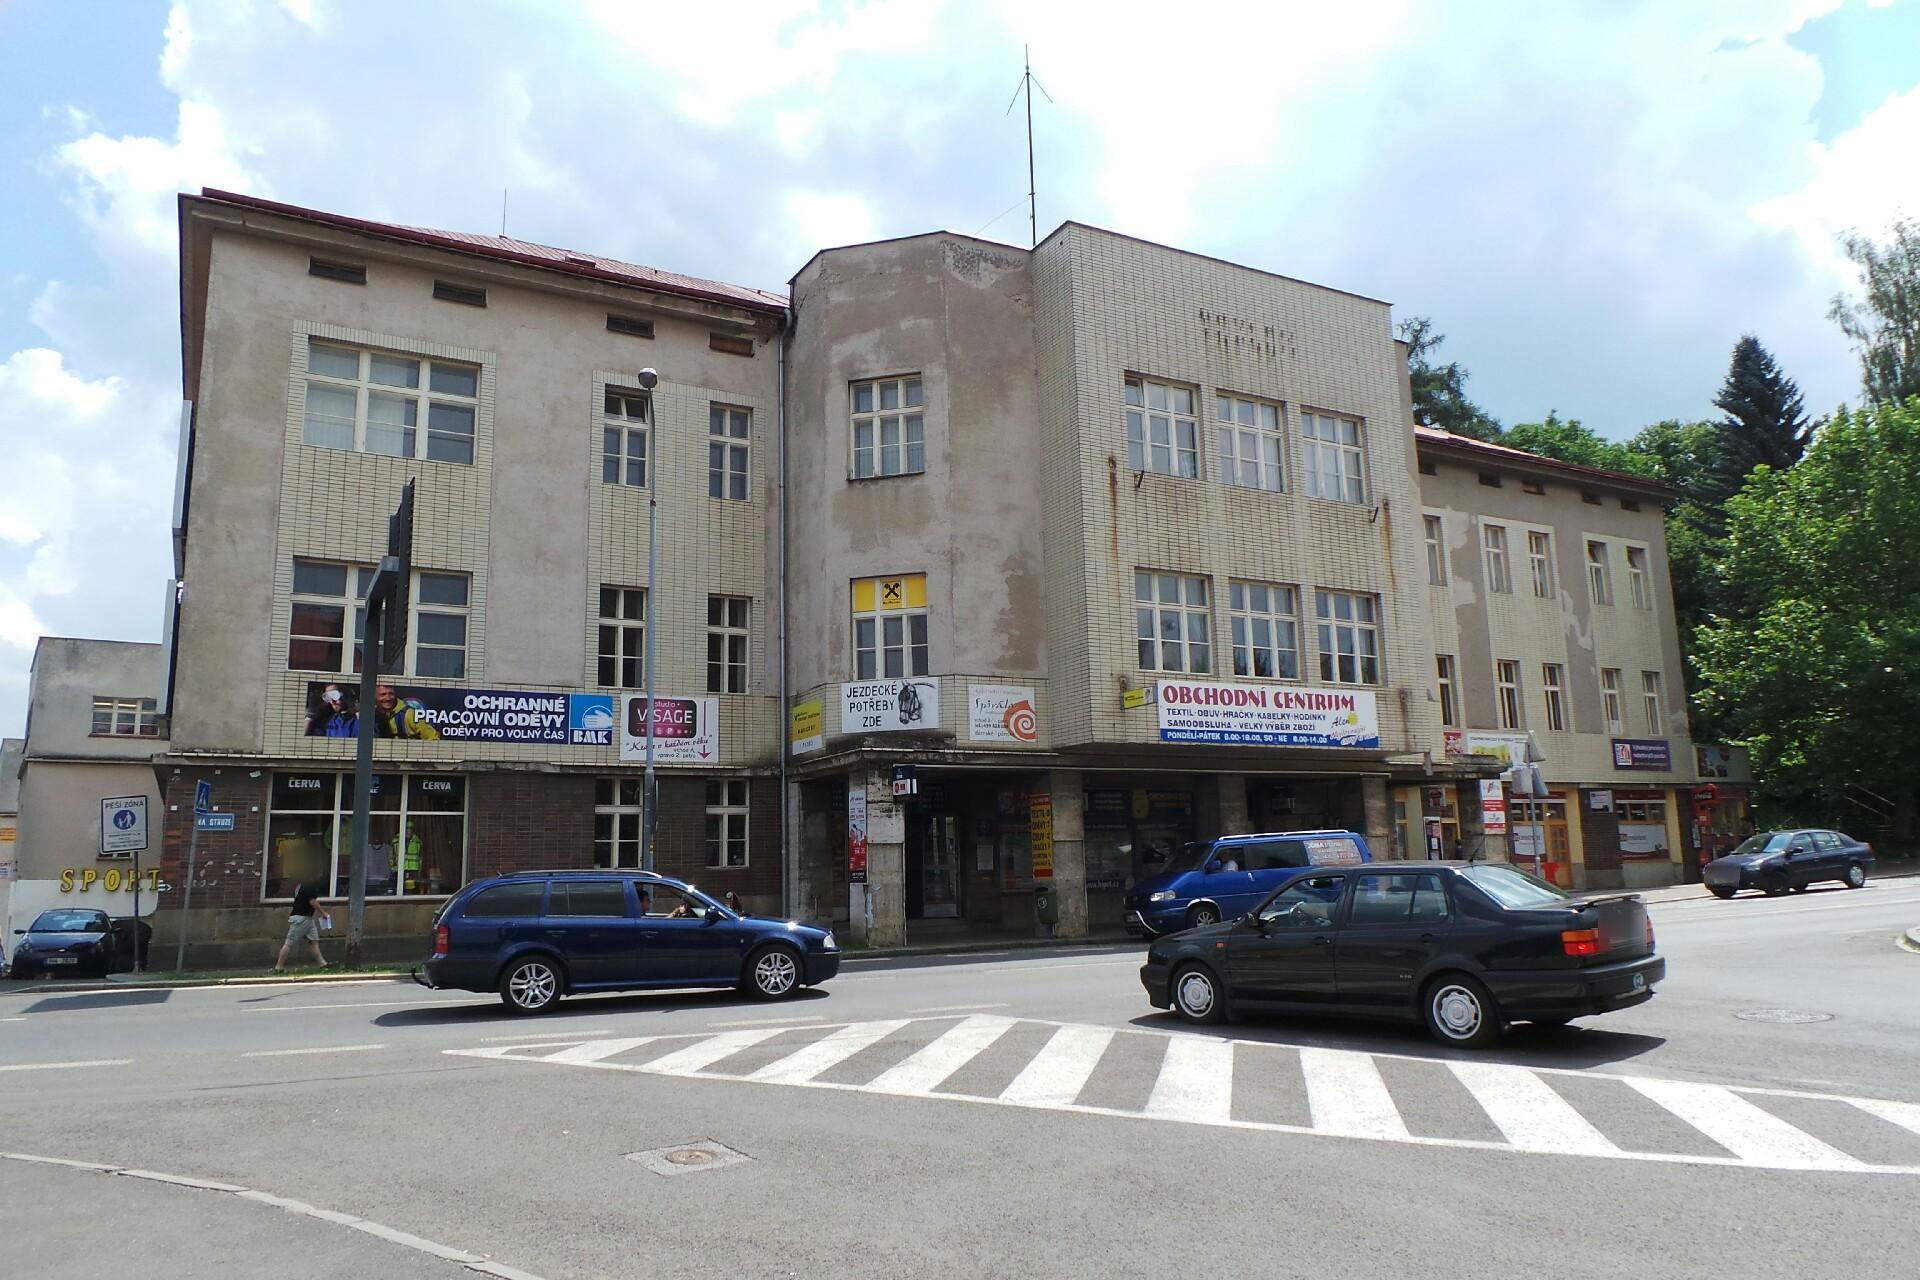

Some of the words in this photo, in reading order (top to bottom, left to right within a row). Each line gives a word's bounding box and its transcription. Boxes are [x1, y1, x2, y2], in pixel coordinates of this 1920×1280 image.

[847, 681, 897, 698] JEZDECKÉ
[464, 695, 565, 713] OCHRANNÉ
[849, 697, 895, 713] POTŘEBY
[1163, 685, 1267, 708] OBCHODNÍ
[1273, 691, 1355, 711] CENTRUM
[414, 709, 499, 726] PRACOVNÍ
[503, 711, 565, 728] ODĚVY
[637, 708, 693, 724] VSAGE
[863, 716, 882, 728] ZDE
[442, 725, 479, 737] ODĚVY
[481, 727, 504, 738] PRO
[507, 727, 541, 739] VOLNÝ
[543, 728, 565, 740] ČAS
[1167, 719, 1232, 729] SAMOOBSLUHA
[1238, 721, 1263, 730] VELKÝ
[573, 730, 609, 744] BMK
[1167, 730, 1221, 741] PONDĚLÍ-PÁTEK
[60, 868, 160, 892] SPORT
